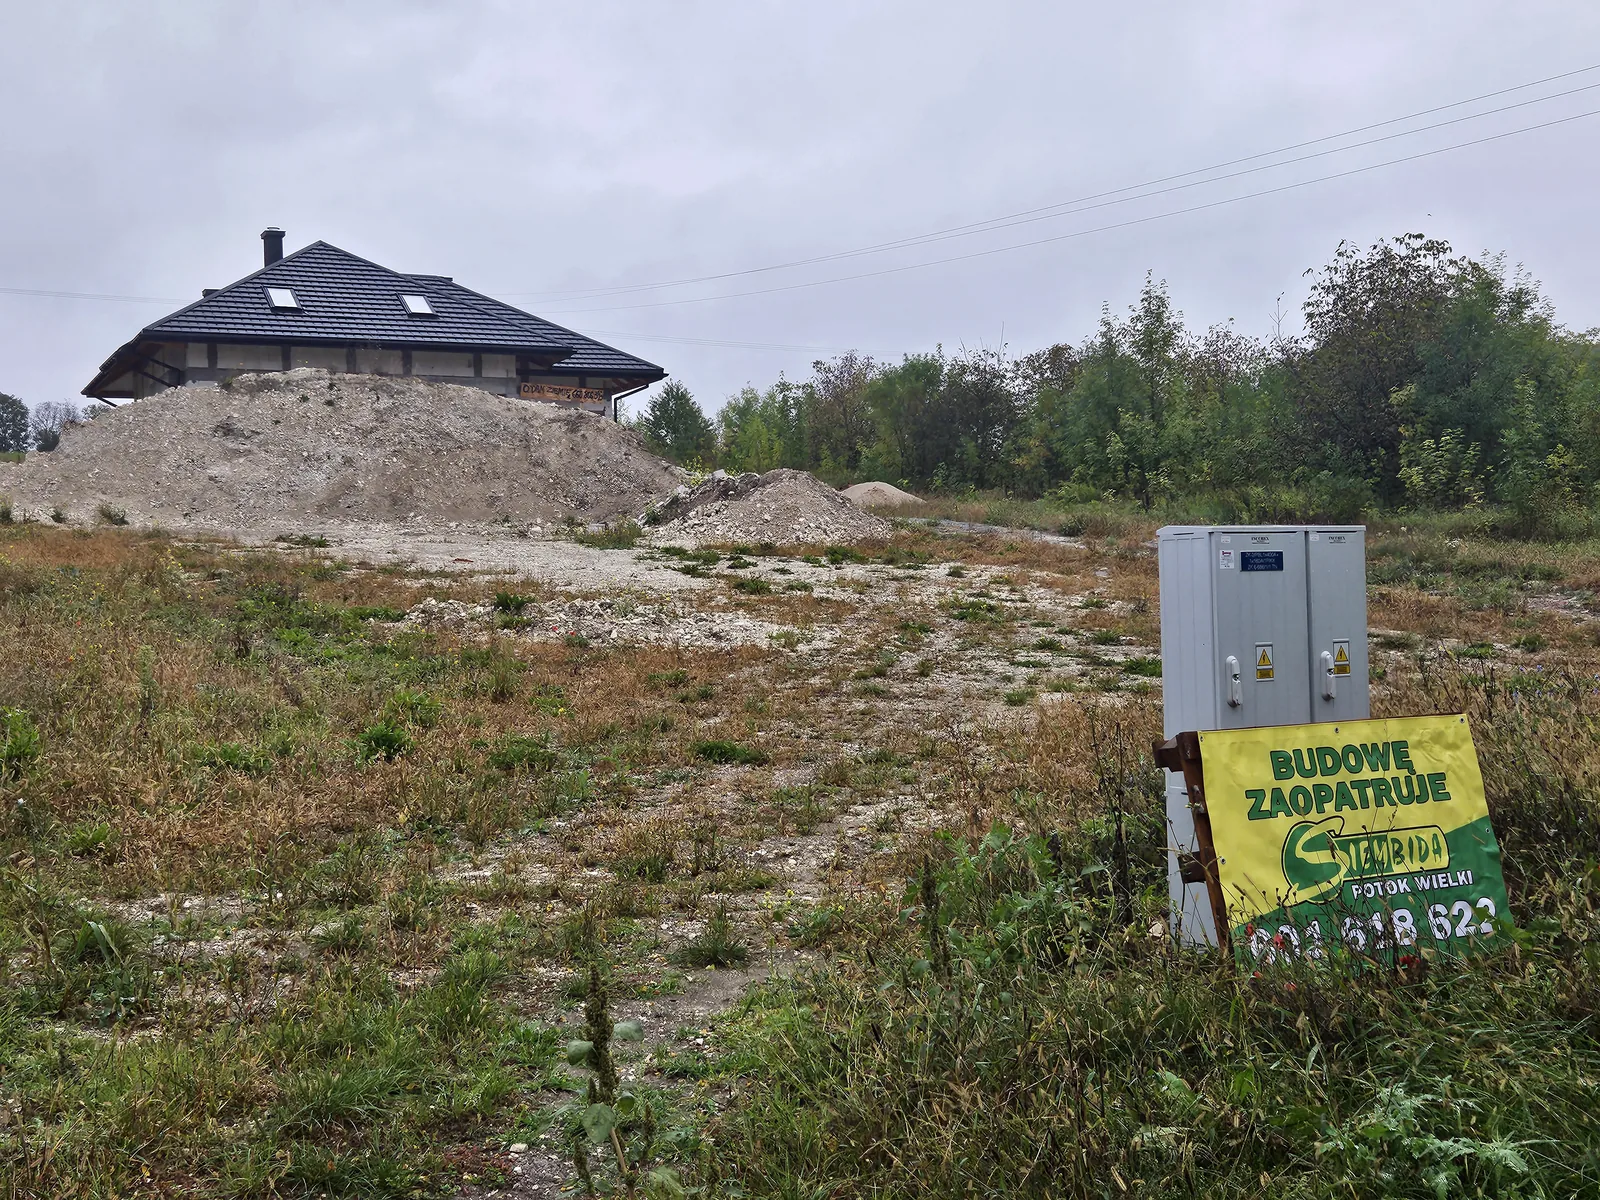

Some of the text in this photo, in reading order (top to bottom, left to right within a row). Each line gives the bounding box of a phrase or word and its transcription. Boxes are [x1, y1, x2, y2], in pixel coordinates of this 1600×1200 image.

[1270, 740, 1416, 780] BUDOWĘ
[1245, 772, 1451, 820] ZAOPATRUJE
[1351, 869, 1474, 900] POTOK WIELKI
